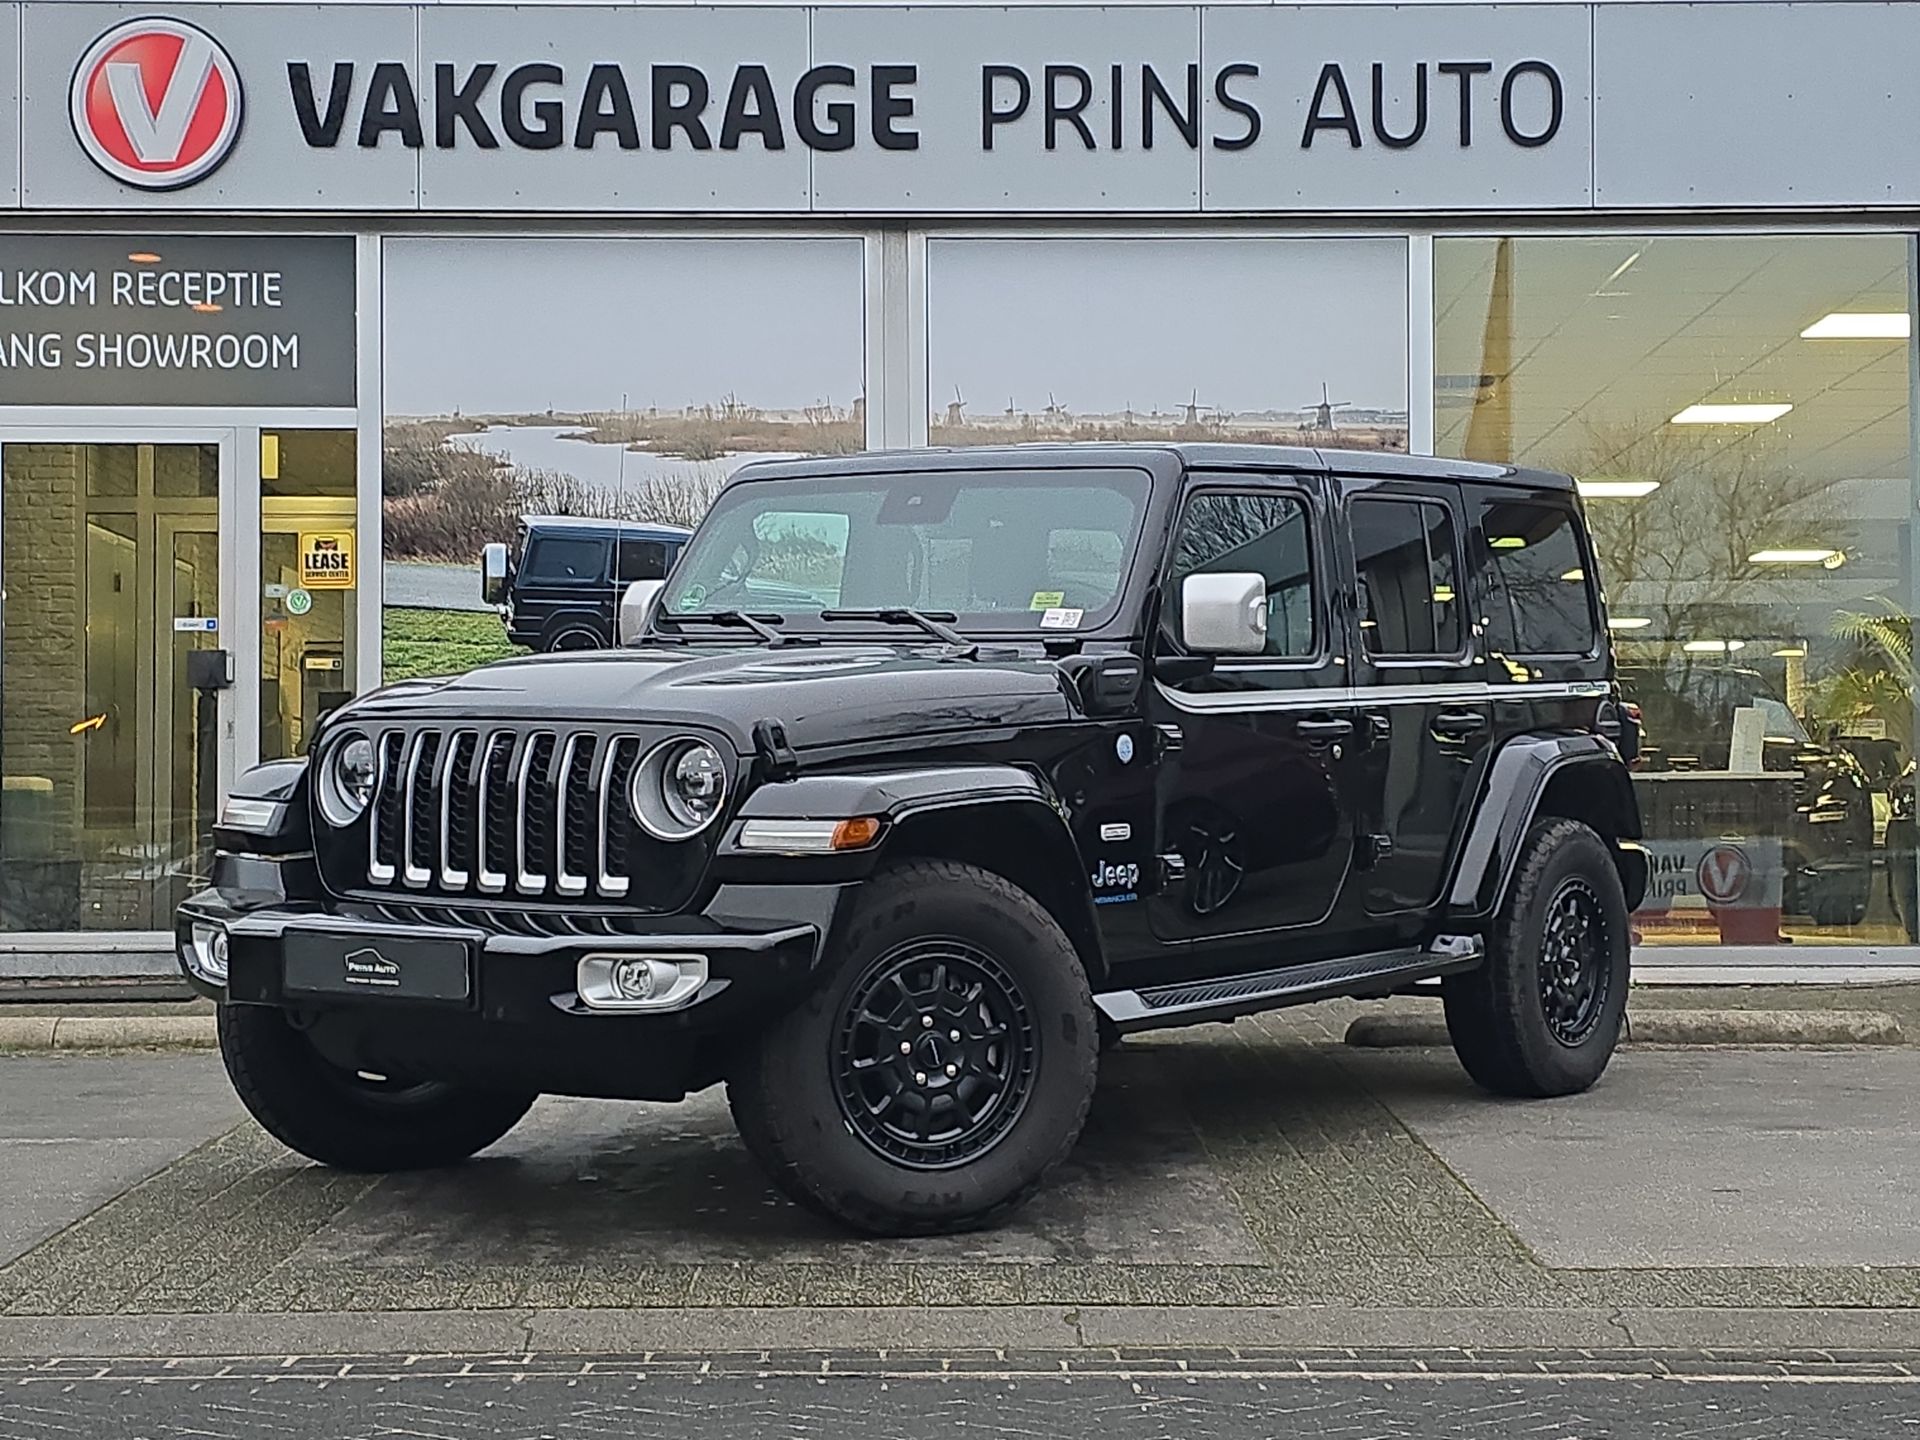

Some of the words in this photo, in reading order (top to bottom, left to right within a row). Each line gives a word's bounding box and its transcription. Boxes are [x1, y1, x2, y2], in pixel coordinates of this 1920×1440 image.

[286, 62, 920, 152] VAKGARAGE
[982, 63, 1261, 152] PRINS
[1300, 60, 1563, 150] AUTO
[0, 271, 96, 306] LKOM
[113, 271, 282, 307] RECEPTIE
[75, 333, 299, 369] SHOWROOM
[304, 553, 349, 570] LEASE
[1091, 860, 1139, 890] Jeep
